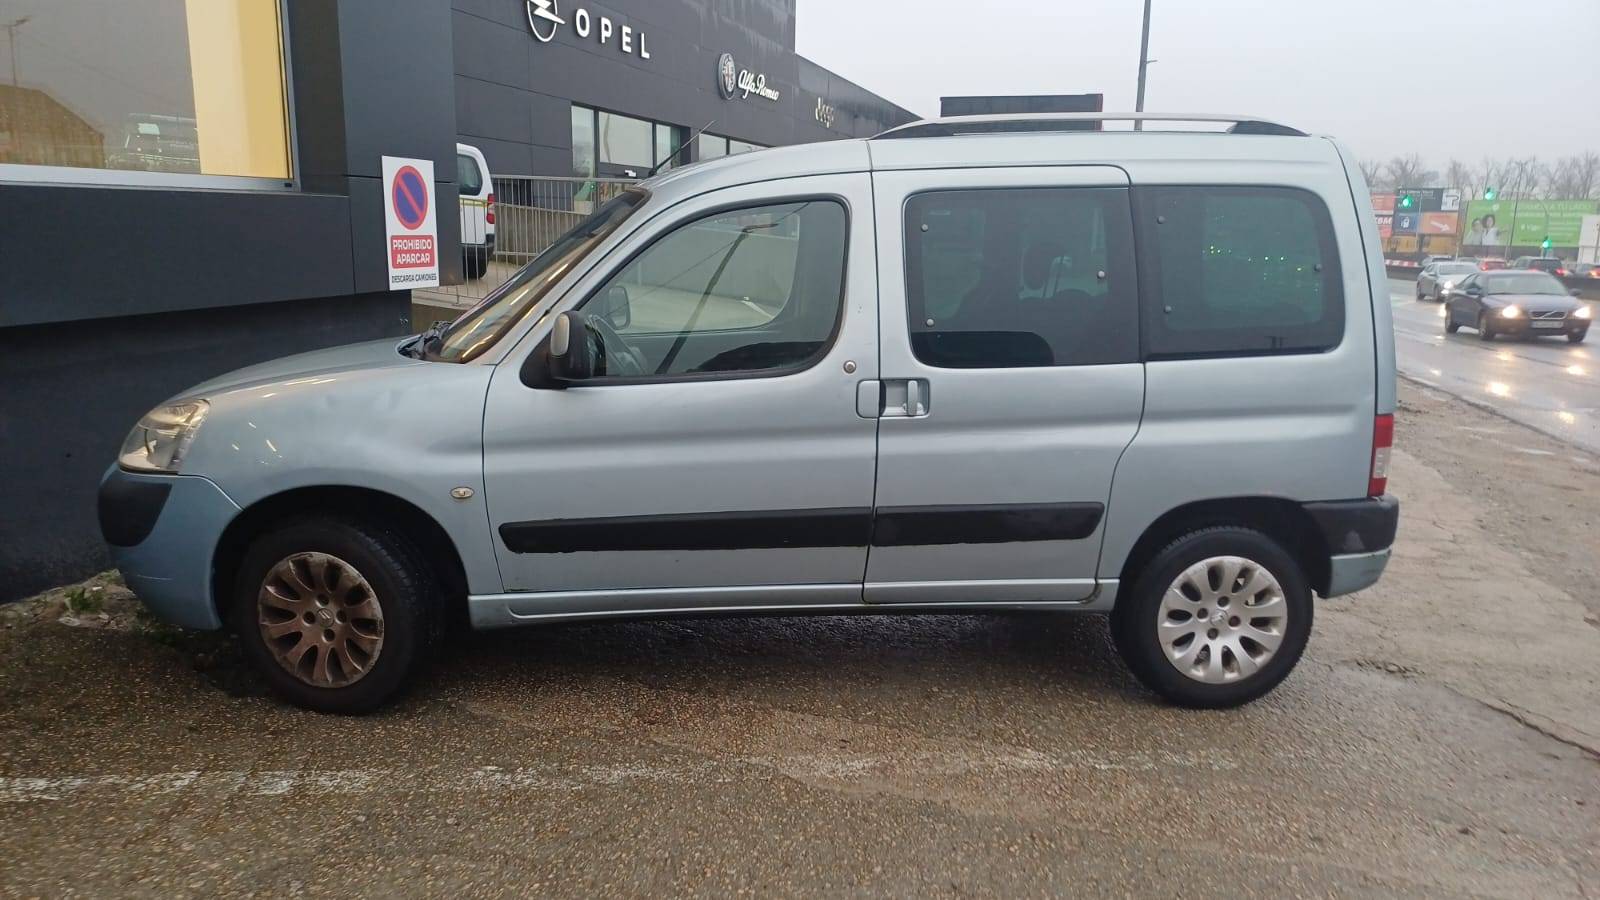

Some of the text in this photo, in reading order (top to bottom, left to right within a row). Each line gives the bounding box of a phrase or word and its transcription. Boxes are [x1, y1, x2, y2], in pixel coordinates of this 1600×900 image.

[575, 8, 650, 59] OPEL
[738, 69, 780, 101] Alfa Romeo
[392, 239, 432, 250] PROHIBIDO
[396, 253, 431, 264] APARCAR
[391, 273, 437, 283] DESCARGA CAMIONES
